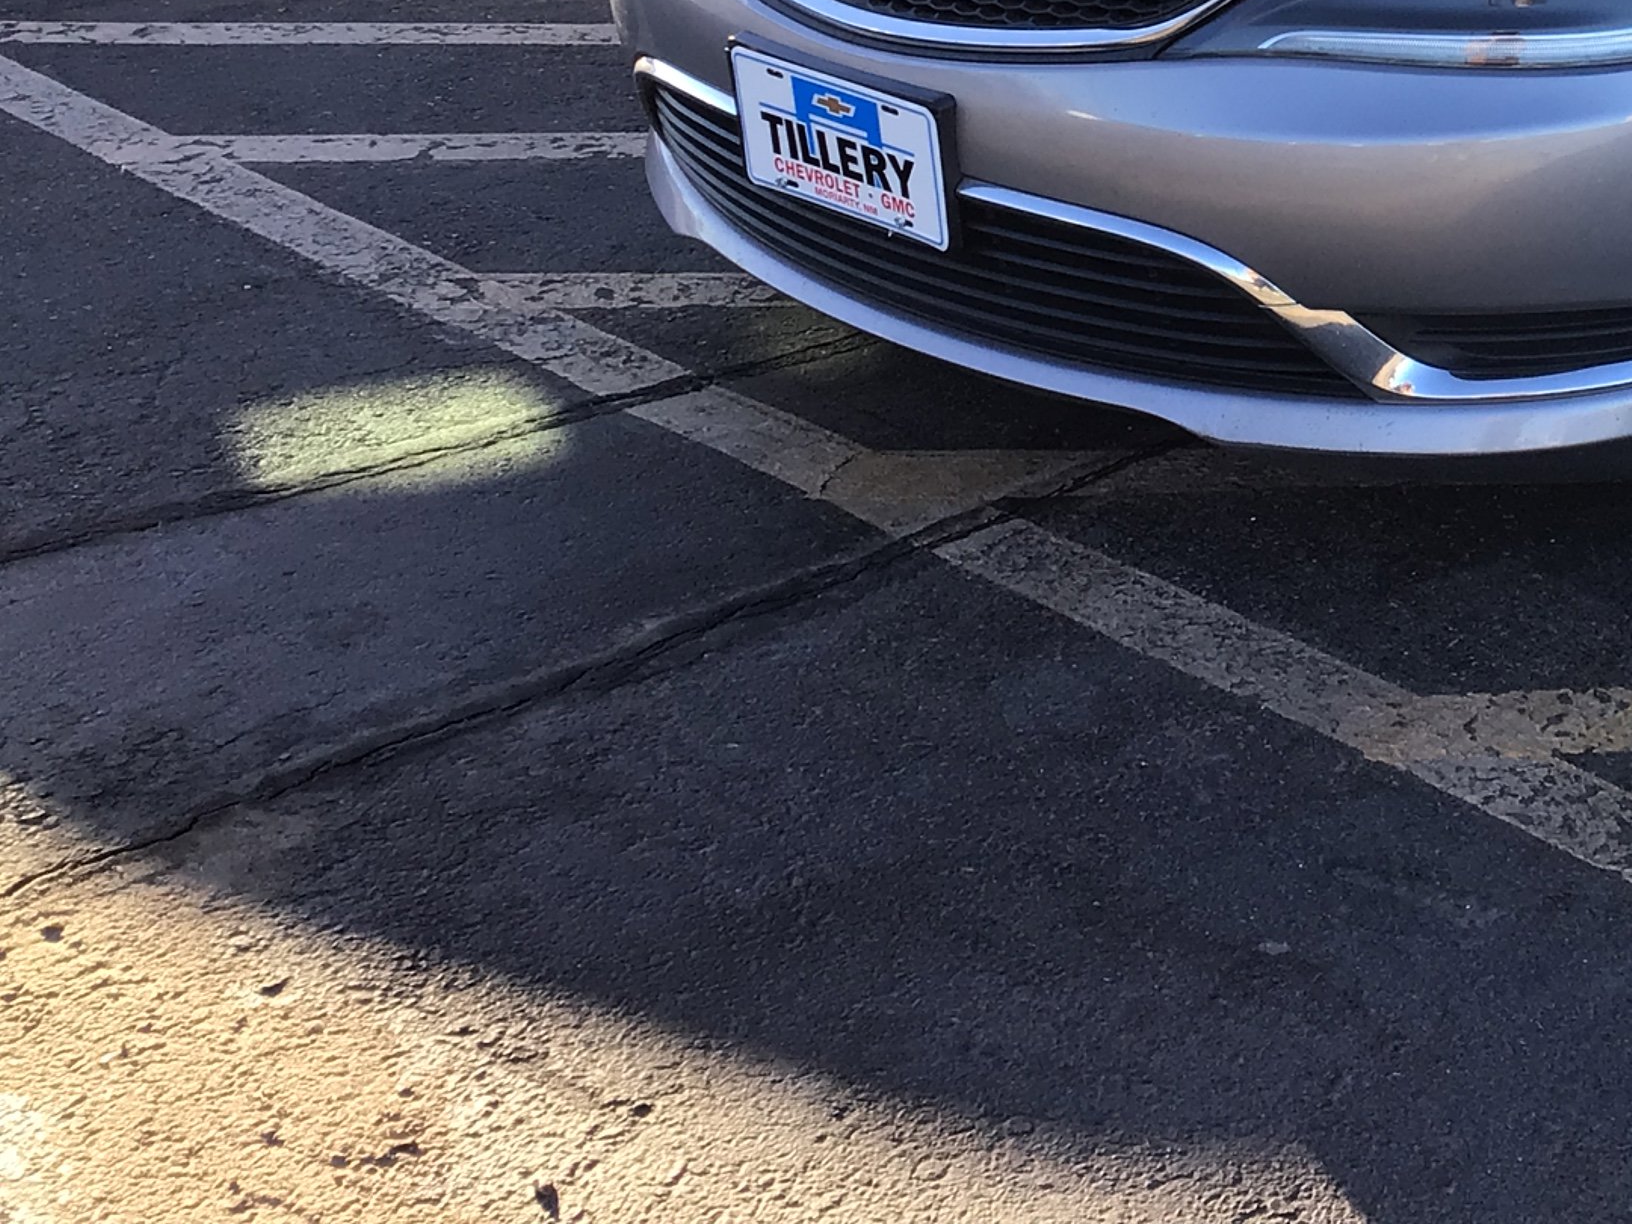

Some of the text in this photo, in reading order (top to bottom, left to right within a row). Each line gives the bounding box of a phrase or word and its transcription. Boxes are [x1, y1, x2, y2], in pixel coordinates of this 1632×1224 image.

[760, 110, 915, 199] TILLERY
[774, 156, 915, 219] CHEVROLET GMC
